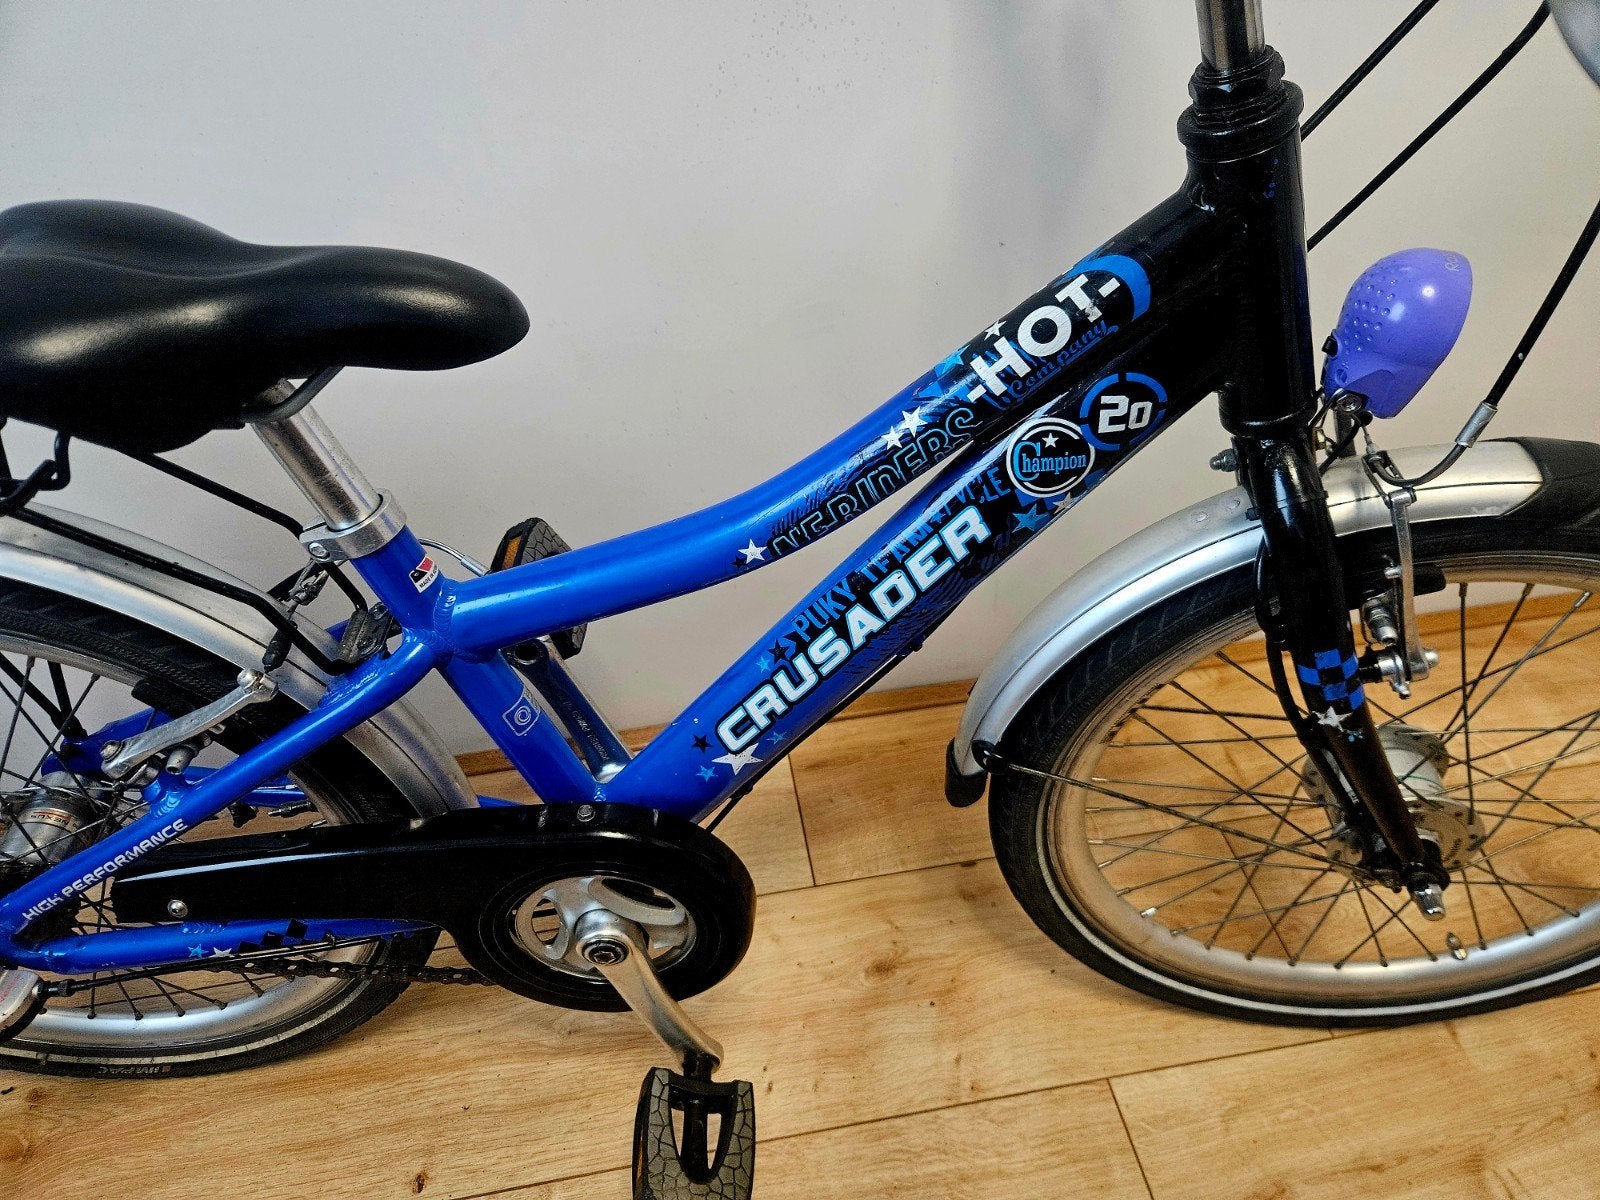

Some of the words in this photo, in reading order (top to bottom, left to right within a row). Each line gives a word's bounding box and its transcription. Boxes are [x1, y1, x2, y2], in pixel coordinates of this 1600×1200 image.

[1097, 395, 1153, 434] 20
[1013, 441, 1087, 481] Champion
[716, 505, 992, 752] CRUSADER
[791, 579, 857, 642] PUKY
[21, 893, 64, 921] HIGH
[61, 818, 189, 897] PERFORMANCE
